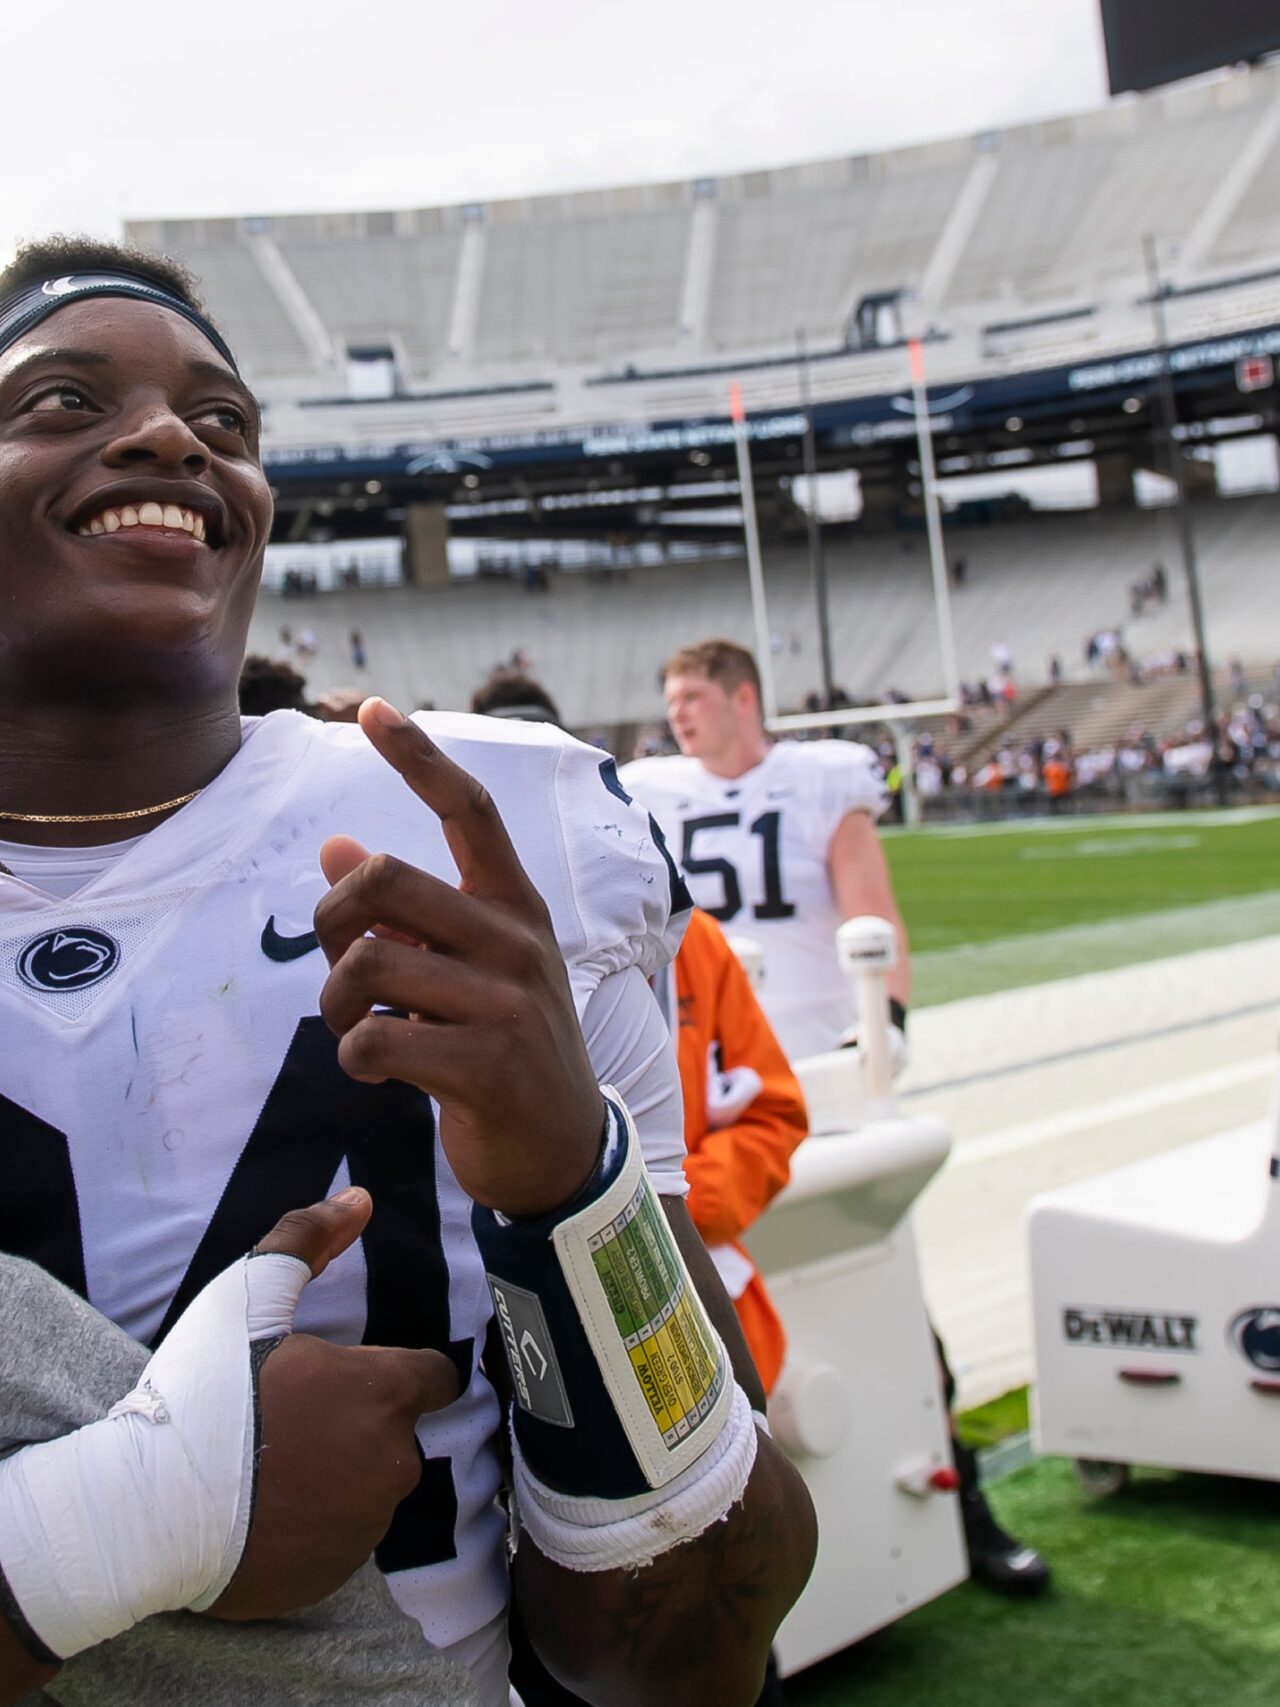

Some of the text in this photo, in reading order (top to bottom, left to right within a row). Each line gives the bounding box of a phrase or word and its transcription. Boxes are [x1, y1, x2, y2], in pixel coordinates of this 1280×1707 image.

[681, 811, 795, 922] 51
[627, 1252, 652, 1301] PROWLER
[494, 1287, 532, 1410] CUTTERS
[667, 1319, 690, 1366] SHOTGUN
[635, 1359, 665, 1416] YELLOW
[648, 1350, 678, 1408] OVER GREEN
[668, 1358, 685, 1387] STUD
